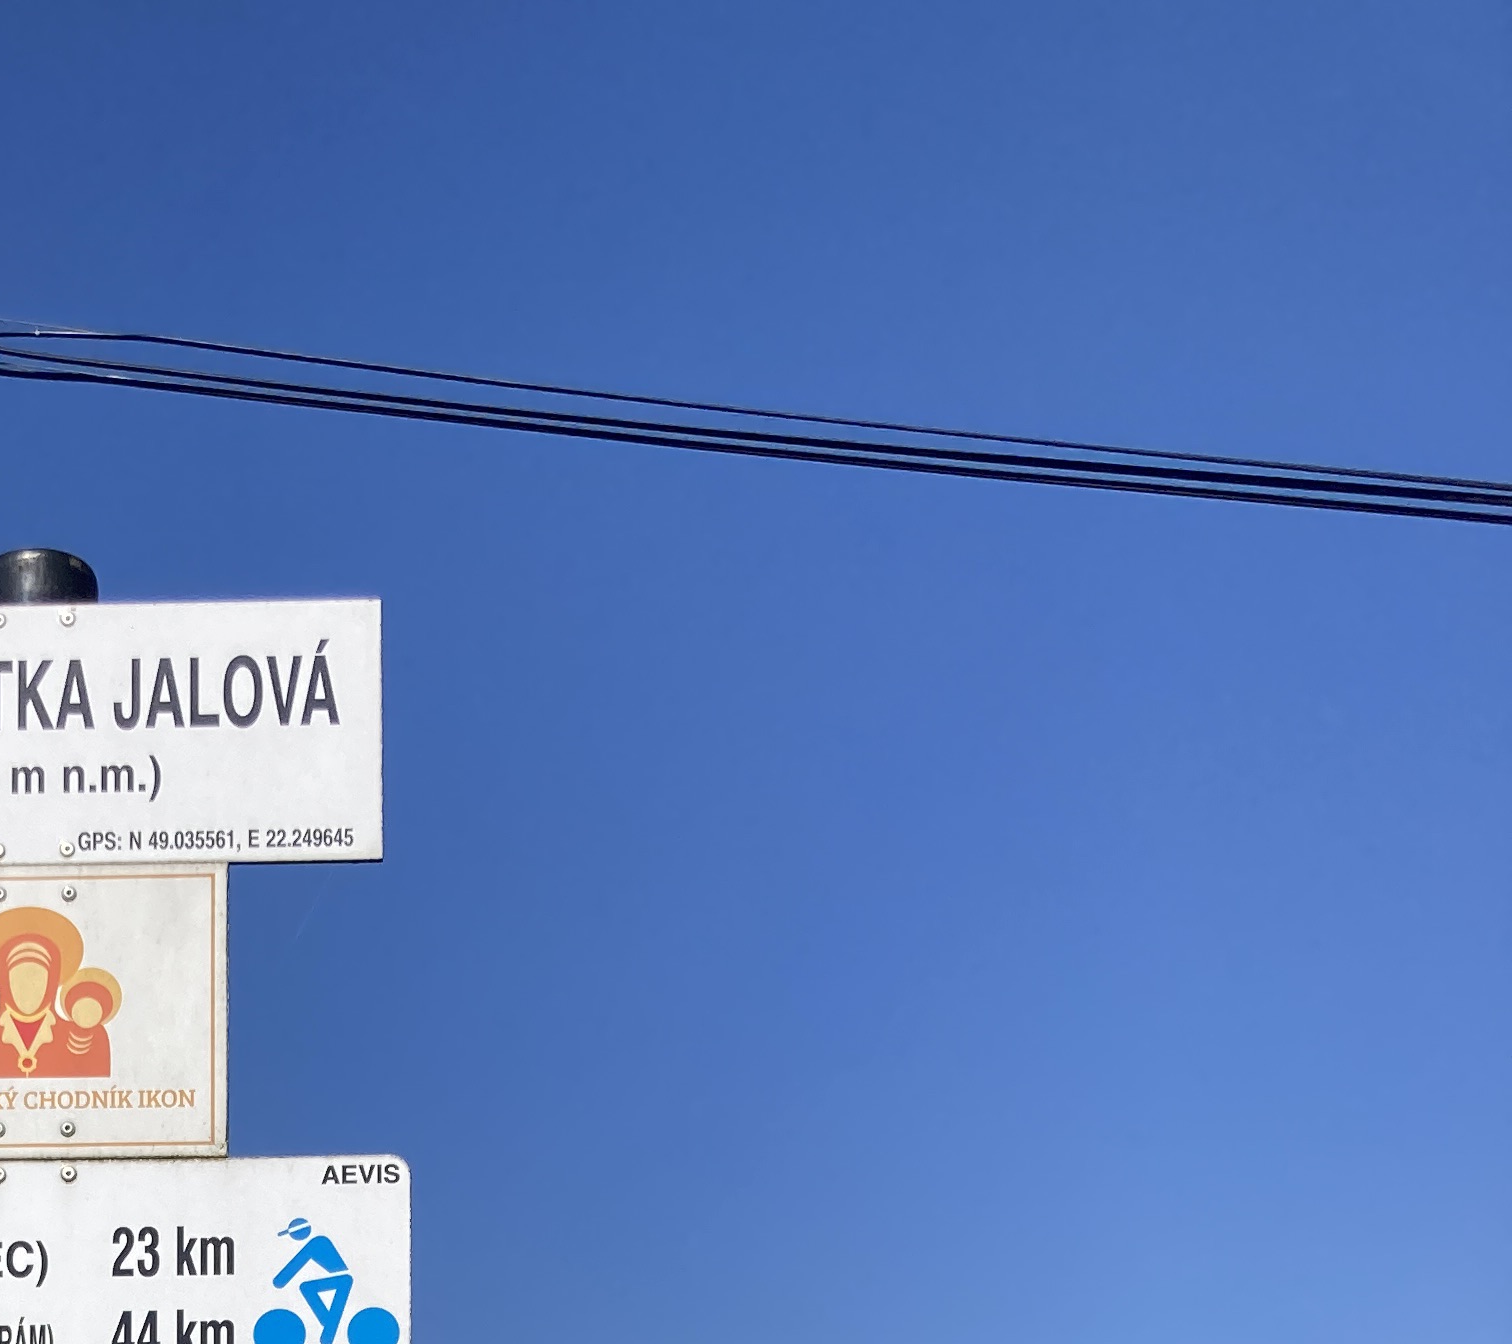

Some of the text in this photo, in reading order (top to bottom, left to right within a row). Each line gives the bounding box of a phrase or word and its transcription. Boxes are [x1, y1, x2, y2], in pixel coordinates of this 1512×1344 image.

[114, 639, 339, 728] JALOVÁ
[12, 767, 44, 793] m
[64, 755, 160, 801] n.m.)
[78, 829, 353, 852] GPS: N 49.035561, E 22.249645
[23, 1085, 132, 1110] CHODNÍK
[139, 1089, 194, 1107] IKON
[322, 1164, 399, 1184] AEVIS
[112, 1227, 159, 1277] 23
[177, 1226, 234, 1275] km
